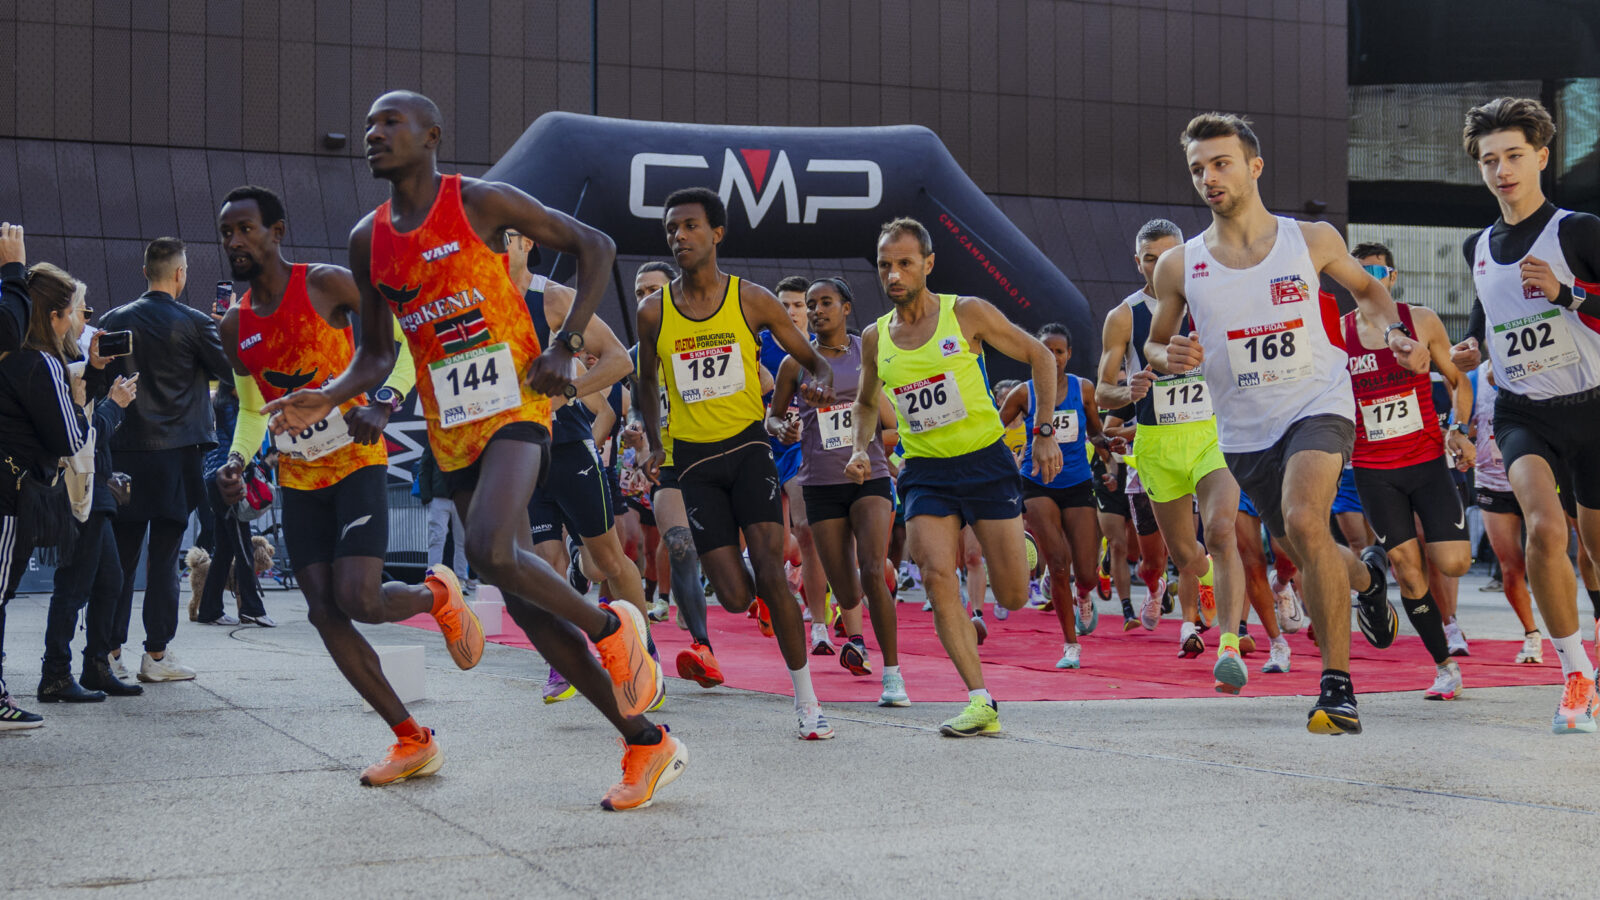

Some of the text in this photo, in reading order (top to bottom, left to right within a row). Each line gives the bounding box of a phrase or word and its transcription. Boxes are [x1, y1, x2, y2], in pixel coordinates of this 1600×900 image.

[629, 147, 882, 229] CMP
[422, 241, 460, 263] VAM
[939, 213, 1031, 309] CMP.CAMPAGNOLO.IT
[1251, 325, 1264, 334] KM
[1265, 322, 1286, 332] FIDAL
[1512, 319, 1523, 328] KM
[1524, 314, 1544, 325] FIDAL
[696, 332, 736, 342] BRUGNERA
[1244, 331, 1296, 363] 168
[1505, 322, 1555, 357] 202
[453, 354, 464, 363] KM
[465, 348, 486, 360] FIDAL
[706, 347, 724, 356] FIDAL
[1349, 353, 1378, 372] DKR
[446, 357, 499, 396] 144
[687, 354, 730, 381] 187
[913, 379, 932, 390] FIDAL
[1240, 379, 1260, 387] RUN
[684, 393, 701, 401] RUN
[905, 383, 947, 414] 206
[1166, 383, 1203, 406] 112
[1373, 400, 1408, 423] 173
